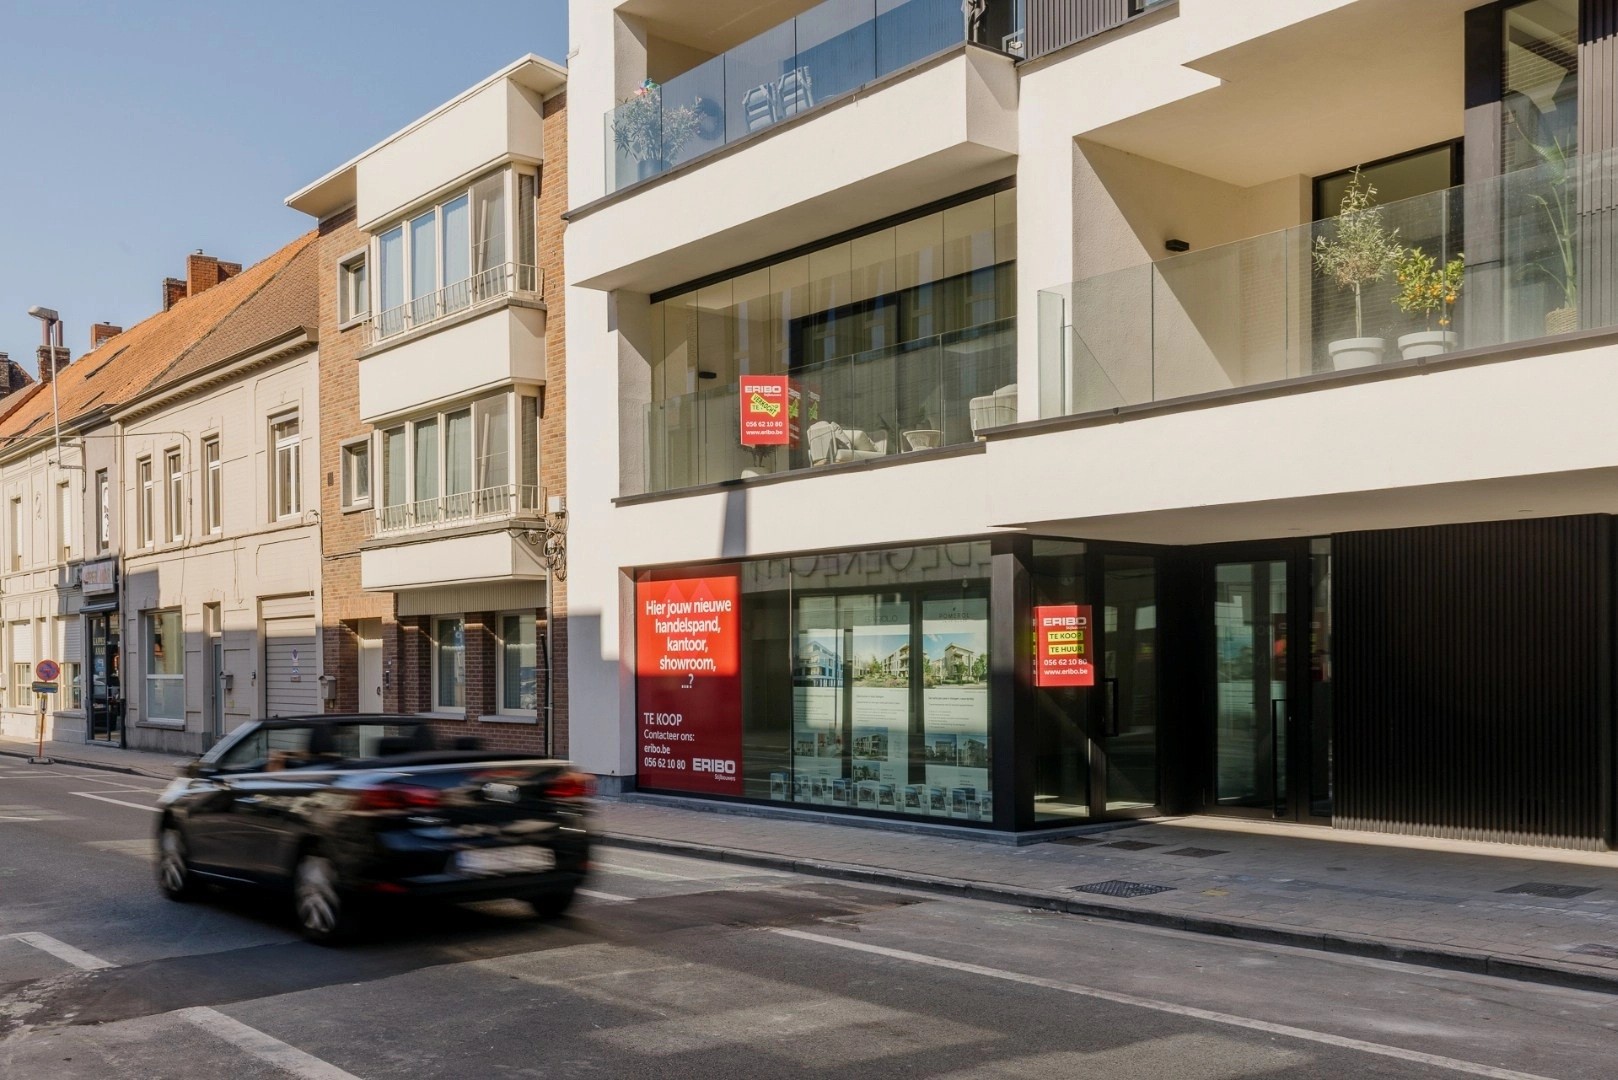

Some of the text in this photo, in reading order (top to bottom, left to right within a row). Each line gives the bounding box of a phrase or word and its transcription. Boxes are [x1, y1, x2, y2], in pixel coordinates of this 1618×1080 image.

[744, 385, 782, 393] ERIBO
[753, 395, 777, 415] VERKOCHT
[646, 597, 732, 618] Hier jouw nieuwe
[655, 616, 721, 636] handelspand,
[1043, 617, 1087, 626] ERIBO
[667, 637, 709, 653] kantoor,
[659, 655, 717, 671] showroom,
[644, 712, 683, 726] TE KOOP
[644, 729, 695, 741] Contacteer ons:
[644, 743, 671, 754] eribo.be
[644, 757, 686, 770] 056 62 10 80
[692, 758, 736, 774] ERIBO
